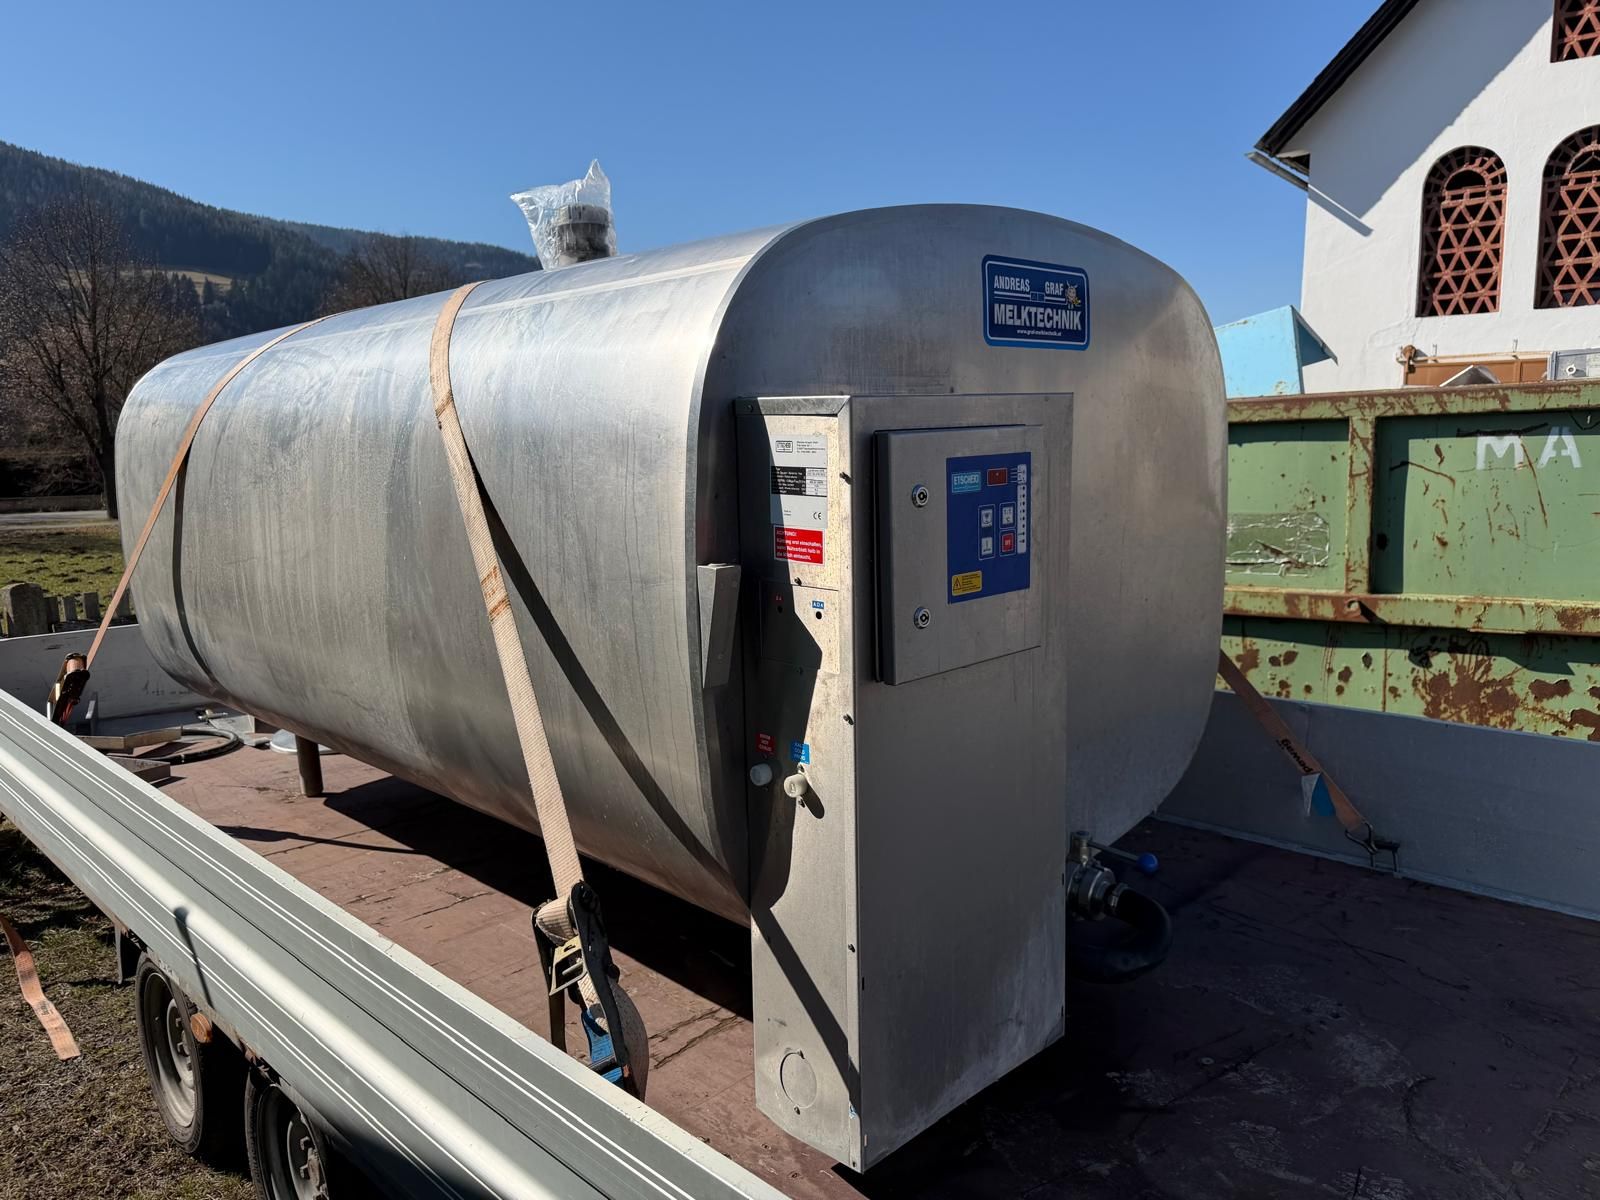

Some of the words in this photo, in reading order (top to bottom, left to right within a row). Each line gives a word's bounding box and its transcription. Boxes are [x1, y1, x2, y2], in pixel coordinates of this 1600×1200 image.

[993, 275, 1030, 292] ANDREAS
[1044, 281, 1064, 296] GRAF
[994, 303, 1082, 330] MELKTECHNIK
